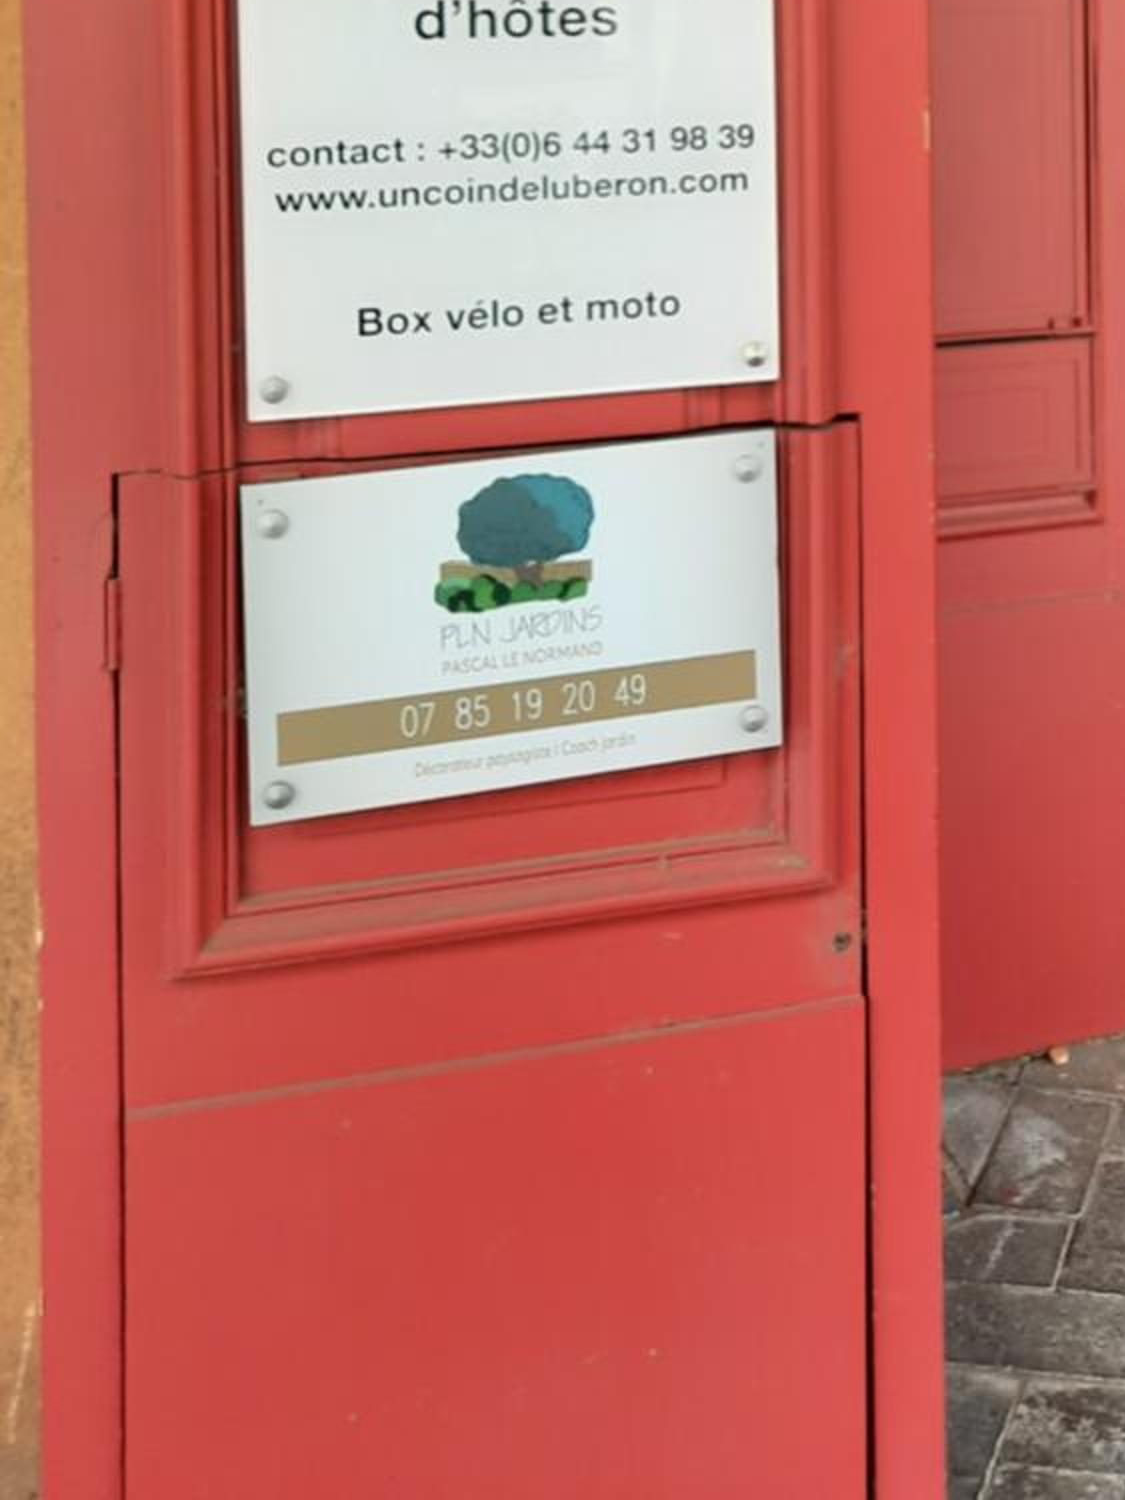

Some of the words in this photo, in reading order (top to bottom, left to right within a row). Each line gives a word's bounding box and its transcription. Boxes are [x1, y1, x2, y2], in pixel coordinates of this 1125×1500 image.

[267, 136, 405, 168] contact
[417, 142, 425, 162] :
[437, 130, 561, 164] +33(0)6
[572, 129, 610, 155] 44
[621, 128, 657, 153] 31
[670, 126, 708, 151] 98
[718, 123, 755, 150] 39
[274, 170, 749, 213] www.uncoindeluberon.com
[357, 306, 432, 337] Box
[445, 300, 525, 332] vélo
[537, 299, 573, 325] et
[585, 293, 681, 322] moto
[440, 617, 491, 650] PLN
[501, 606, 602, 643] JARDINS
[442, 656, 498, 677] PASCAL
[401, 702, 436, 739] 07
[454, 695, 491, 731] 85
[512, 687, 544, 722] 19
[562, 680, 596, 715] 20
[613, 674, 647, 706] 49
